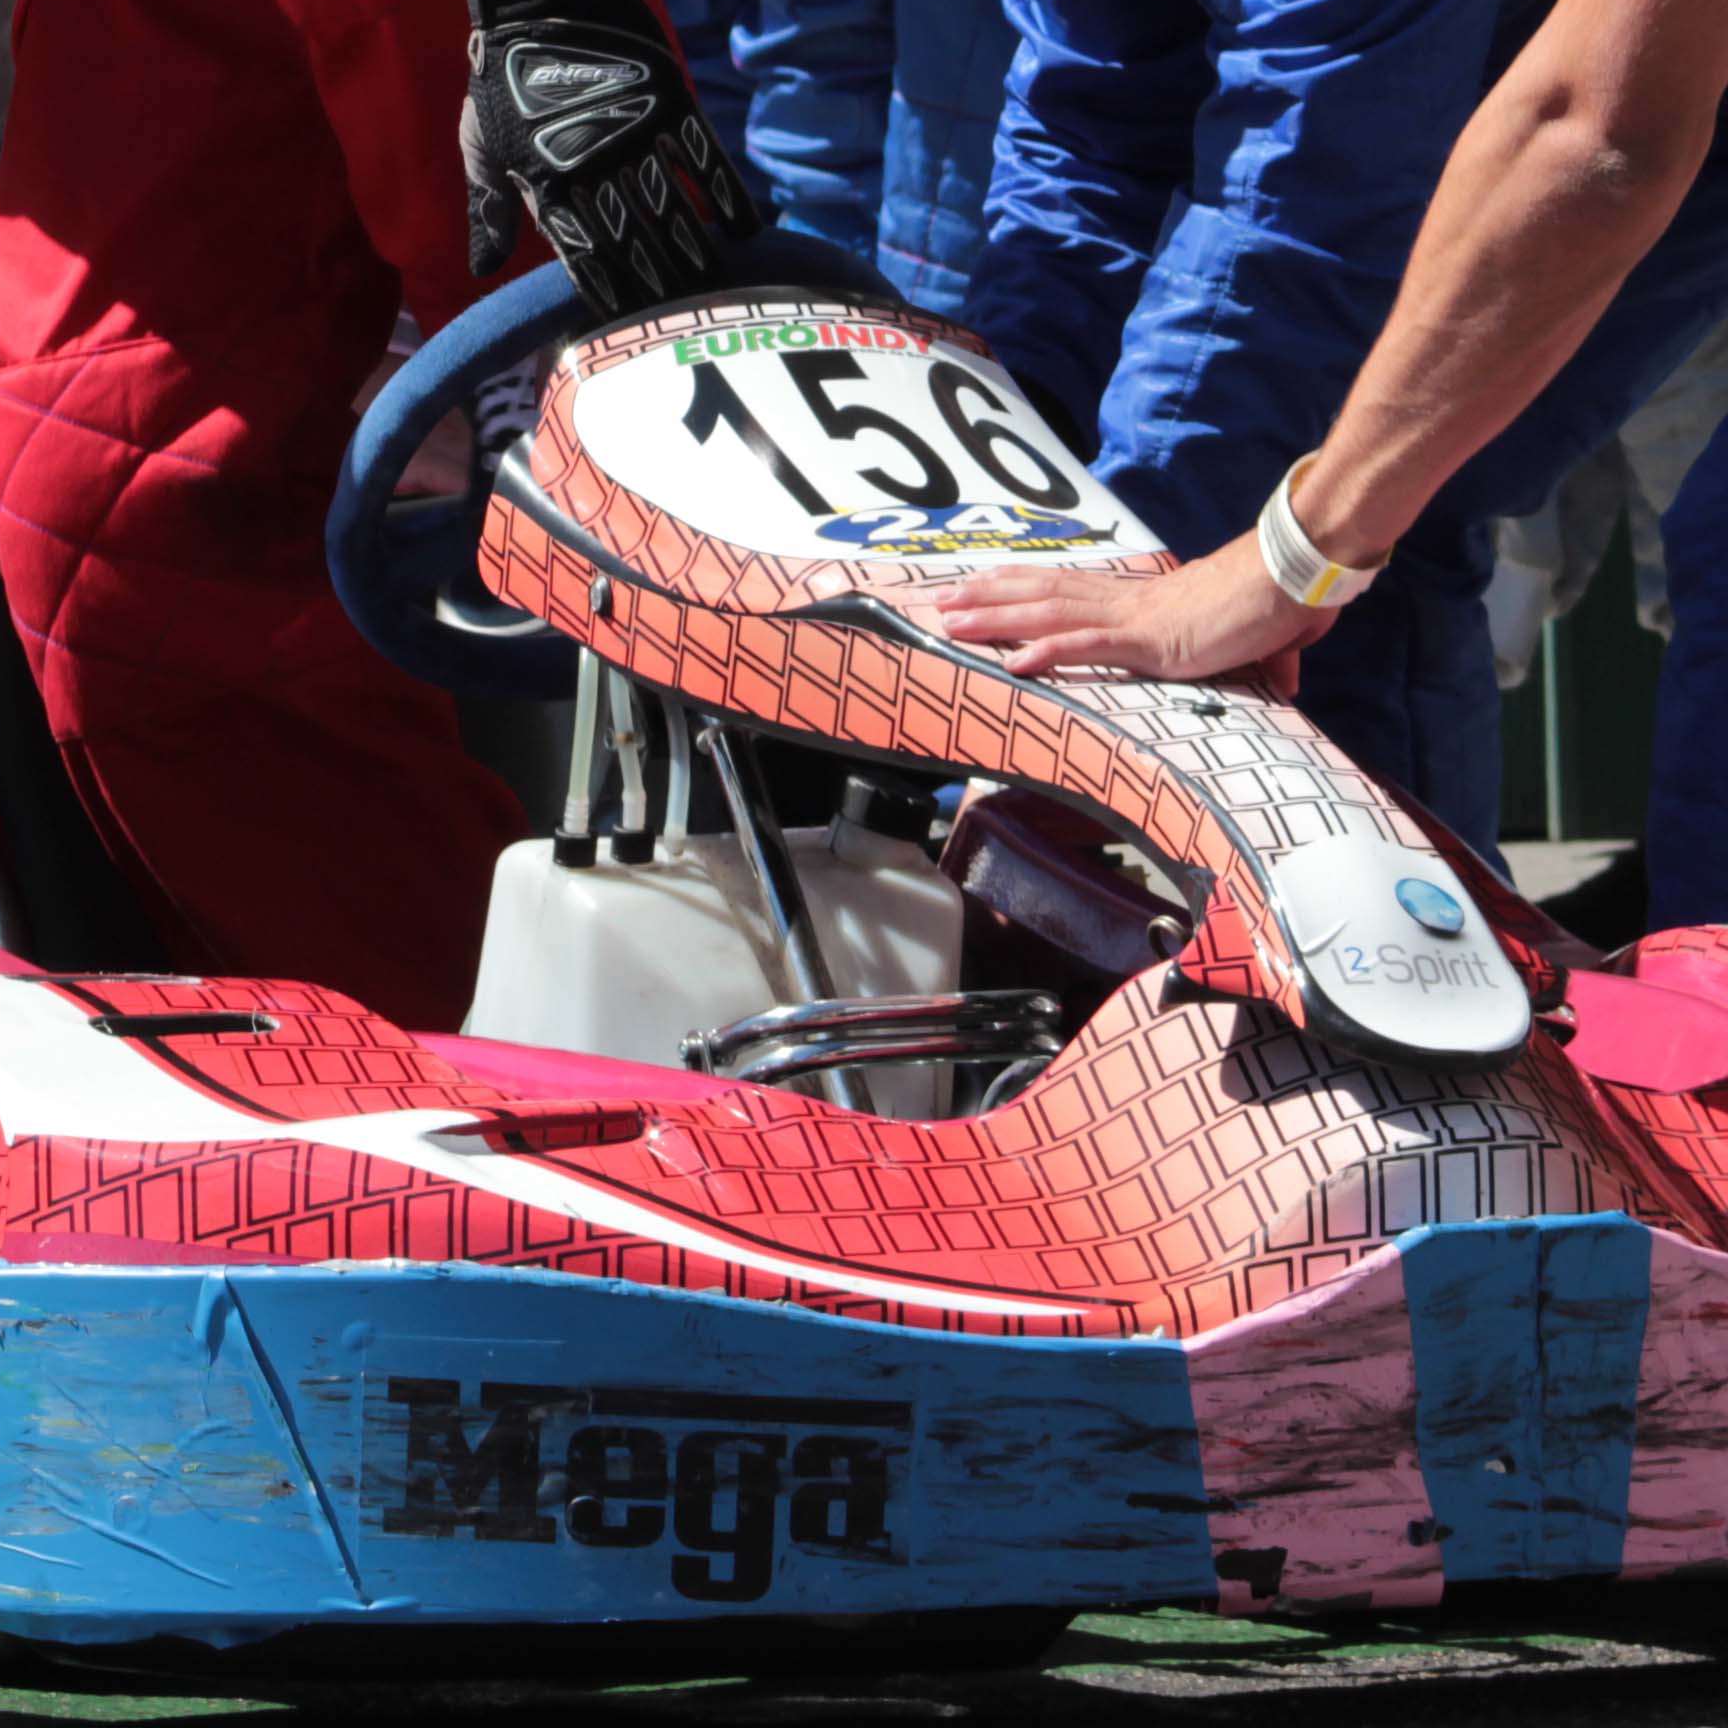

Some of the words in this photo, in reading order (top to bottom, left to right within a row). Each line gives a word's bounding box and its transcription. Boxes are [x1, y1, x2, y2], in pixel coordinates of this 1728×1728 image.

[672, 321, 936, 366] EUROINDY
[681, 348, 1081, 518] 156
[848, 504, 1034, 543] 24
[872, 541, 926, 553] da
[934, 535, 1095, 552] Batalha
[908, 529, 1014, 544] horas
[382, 1374, 913, 1602] Mega
